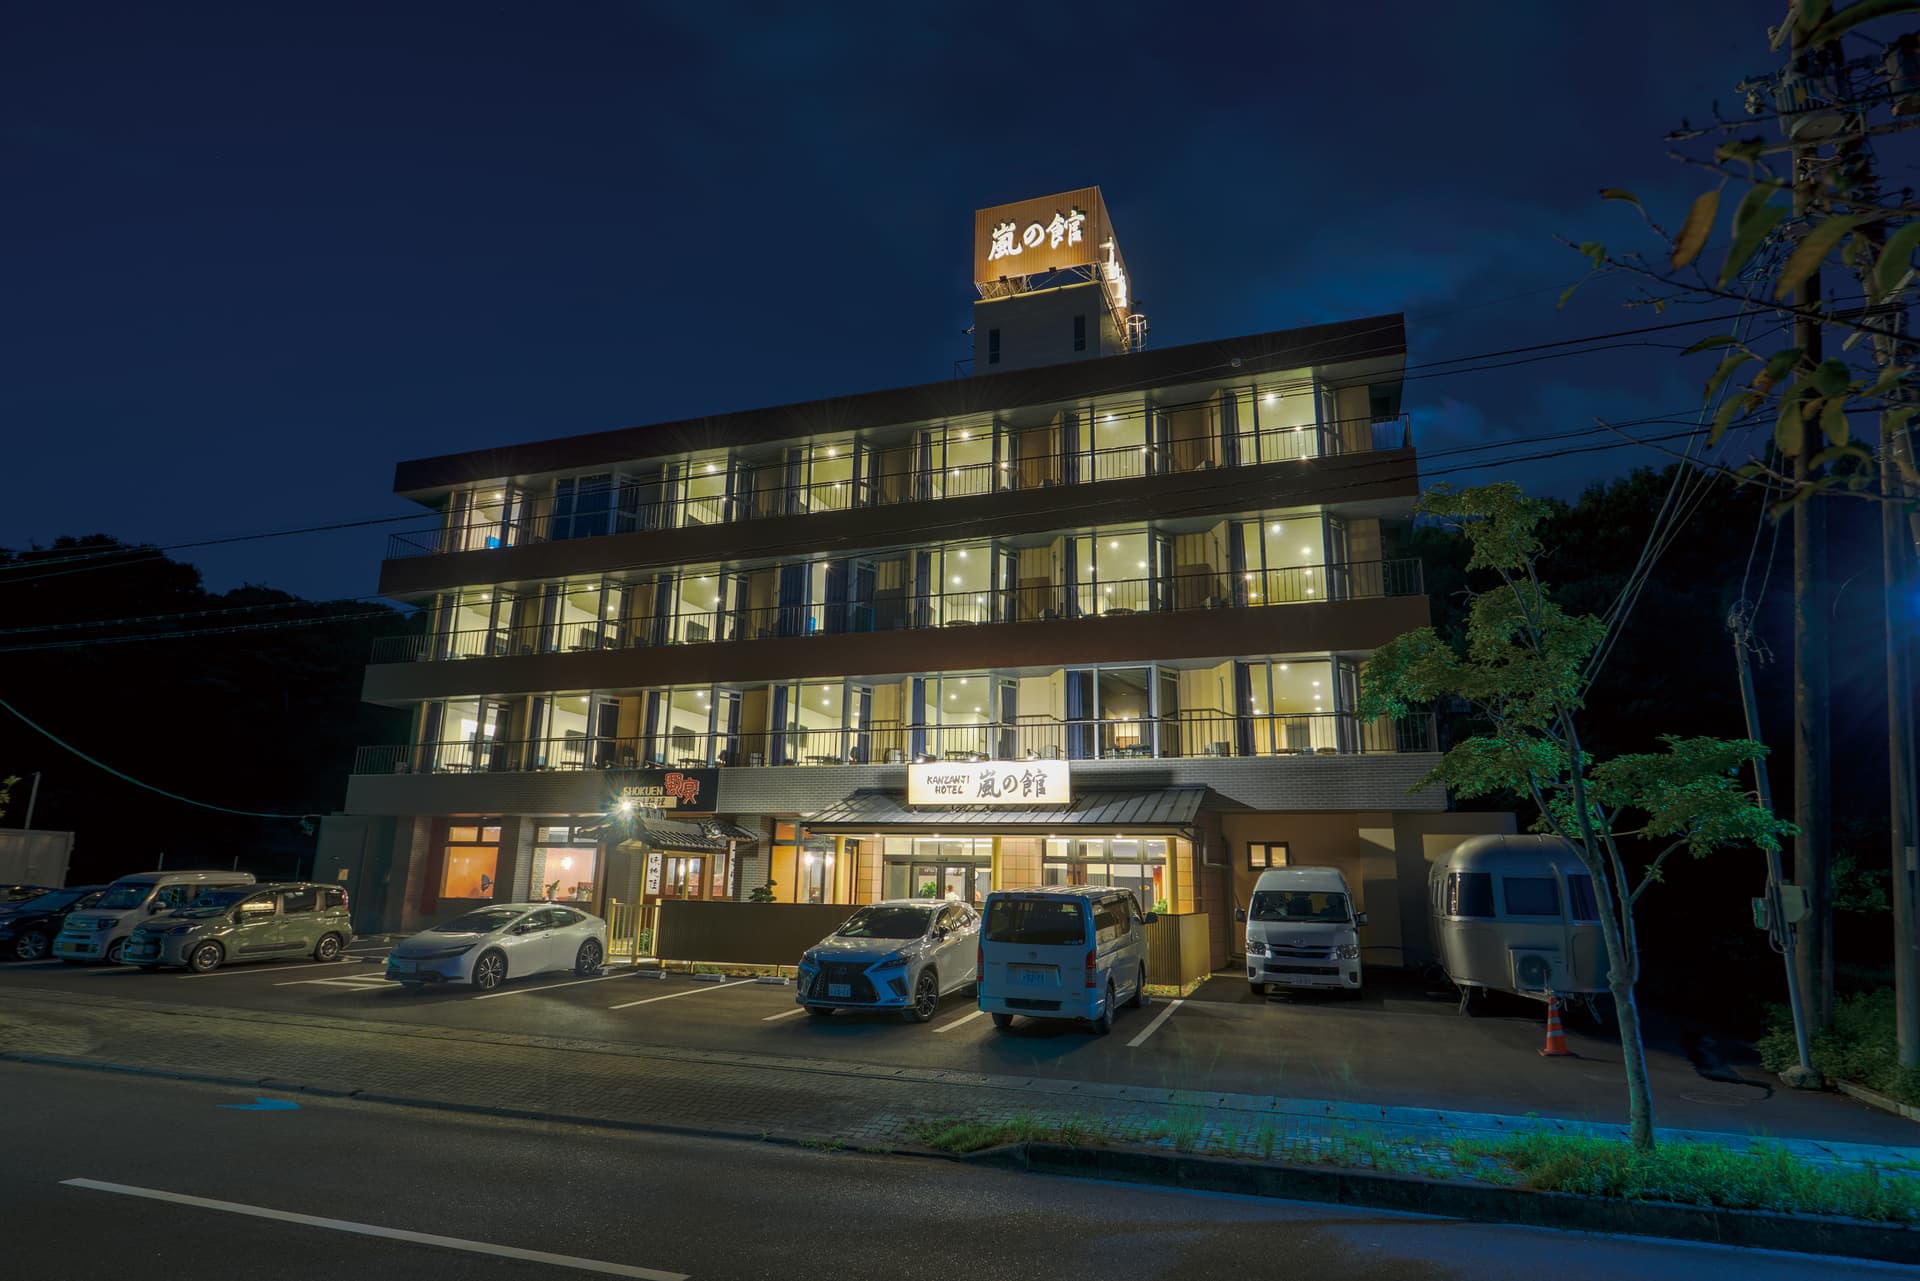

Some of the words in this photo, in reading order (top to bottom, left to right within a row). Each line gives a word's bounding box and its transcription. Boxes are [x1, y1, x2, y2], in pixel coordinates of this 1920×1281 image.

[988, 209, 1086, 261] 嵐の館
[926, 775, 971, 785] KANZANJI
[976, 768, 1048, 799] 嵐の館
[624, 786, 663, 795] SHOKUEN
[935, 785, 964, 794] HOTEL
